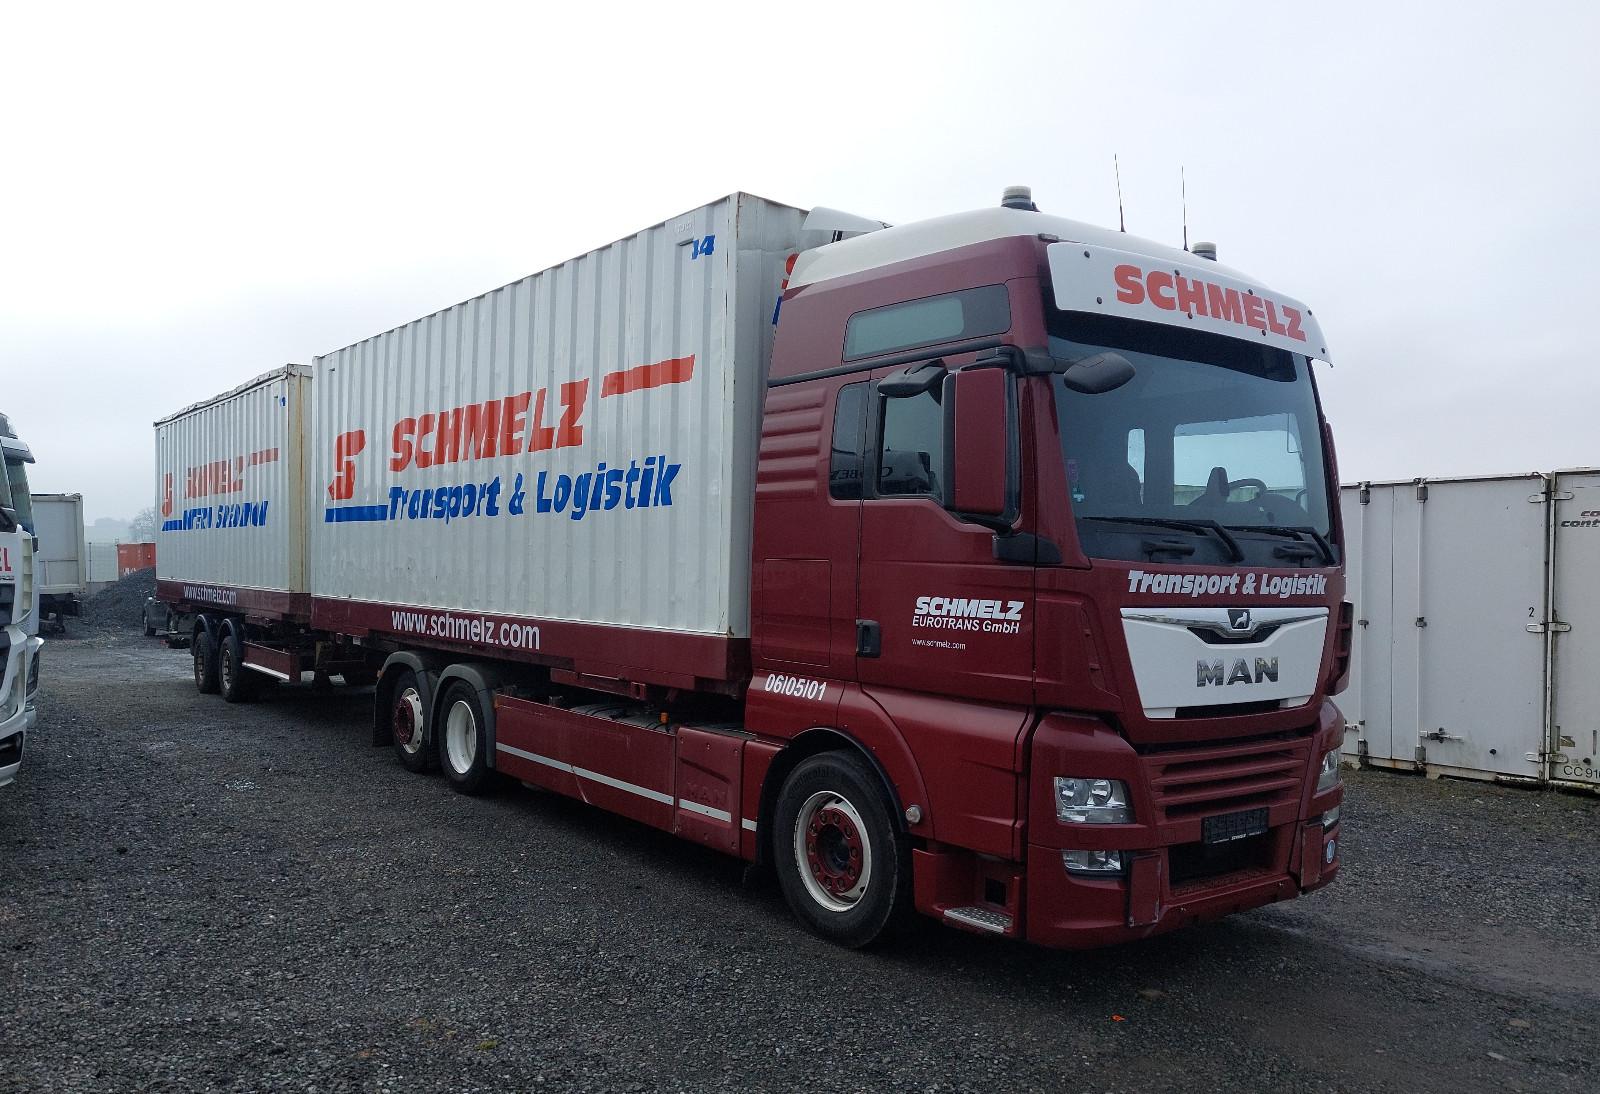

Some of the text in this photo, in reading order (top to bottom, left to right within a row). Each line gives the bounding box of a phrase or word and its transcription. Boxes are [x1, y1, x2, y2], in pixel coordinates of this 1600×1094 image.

[1114, 264, 1306, 342] SCHMELZ
[389, 378, 589, 472] SCHMELZ
[389, 455, 682, 525] Transport & Logistik
[183, 585, 237, 606] www.schmelz.com
[1128, 570, 1328, 599] Transport & Logistik
[914, 596, 1025, 621] SCHMELZ
[1528, 606, 1535, 618] 2
[391, 610, 541, 650] www.schmelz.com
[912, 615, 1020, 634] EUROTRANS GmbH
[1196, 656, 1280, 688] MAN
[1585, 768, 1600, 780] 91
